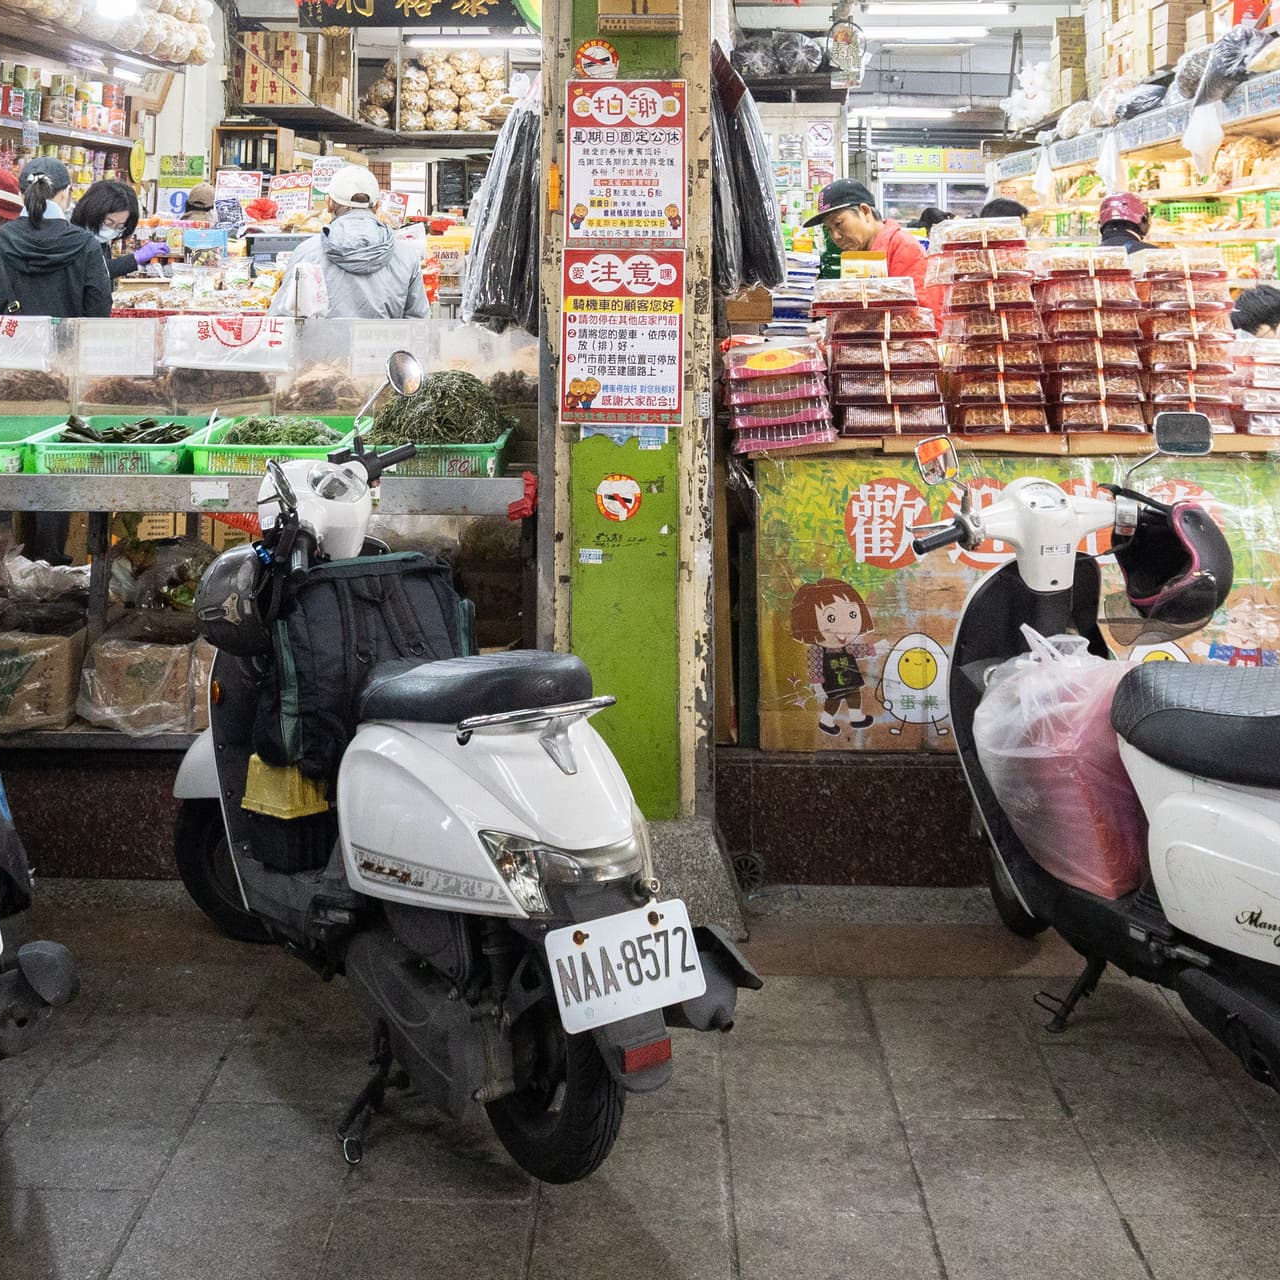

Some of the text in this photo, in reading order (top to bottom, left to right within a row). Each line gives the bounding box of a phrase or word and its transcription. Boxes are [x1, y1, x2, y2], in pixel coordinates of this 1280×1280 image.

[572, 130, 680, 143] 星期日固定公休
[170, 191, 188, 214] 9
[591, 261, 656, 286] 注意
[572, 299, 674, 311] 騎機車的顧客您好
[578, 314, 678, 326] 請勿停在其他店家門前
[577, 354, 677, 365] 門市前若無位置可停放
[601, 396, 676, 407] 感謝大家配合!!
[901, 695, 939, 710] 蛋素
